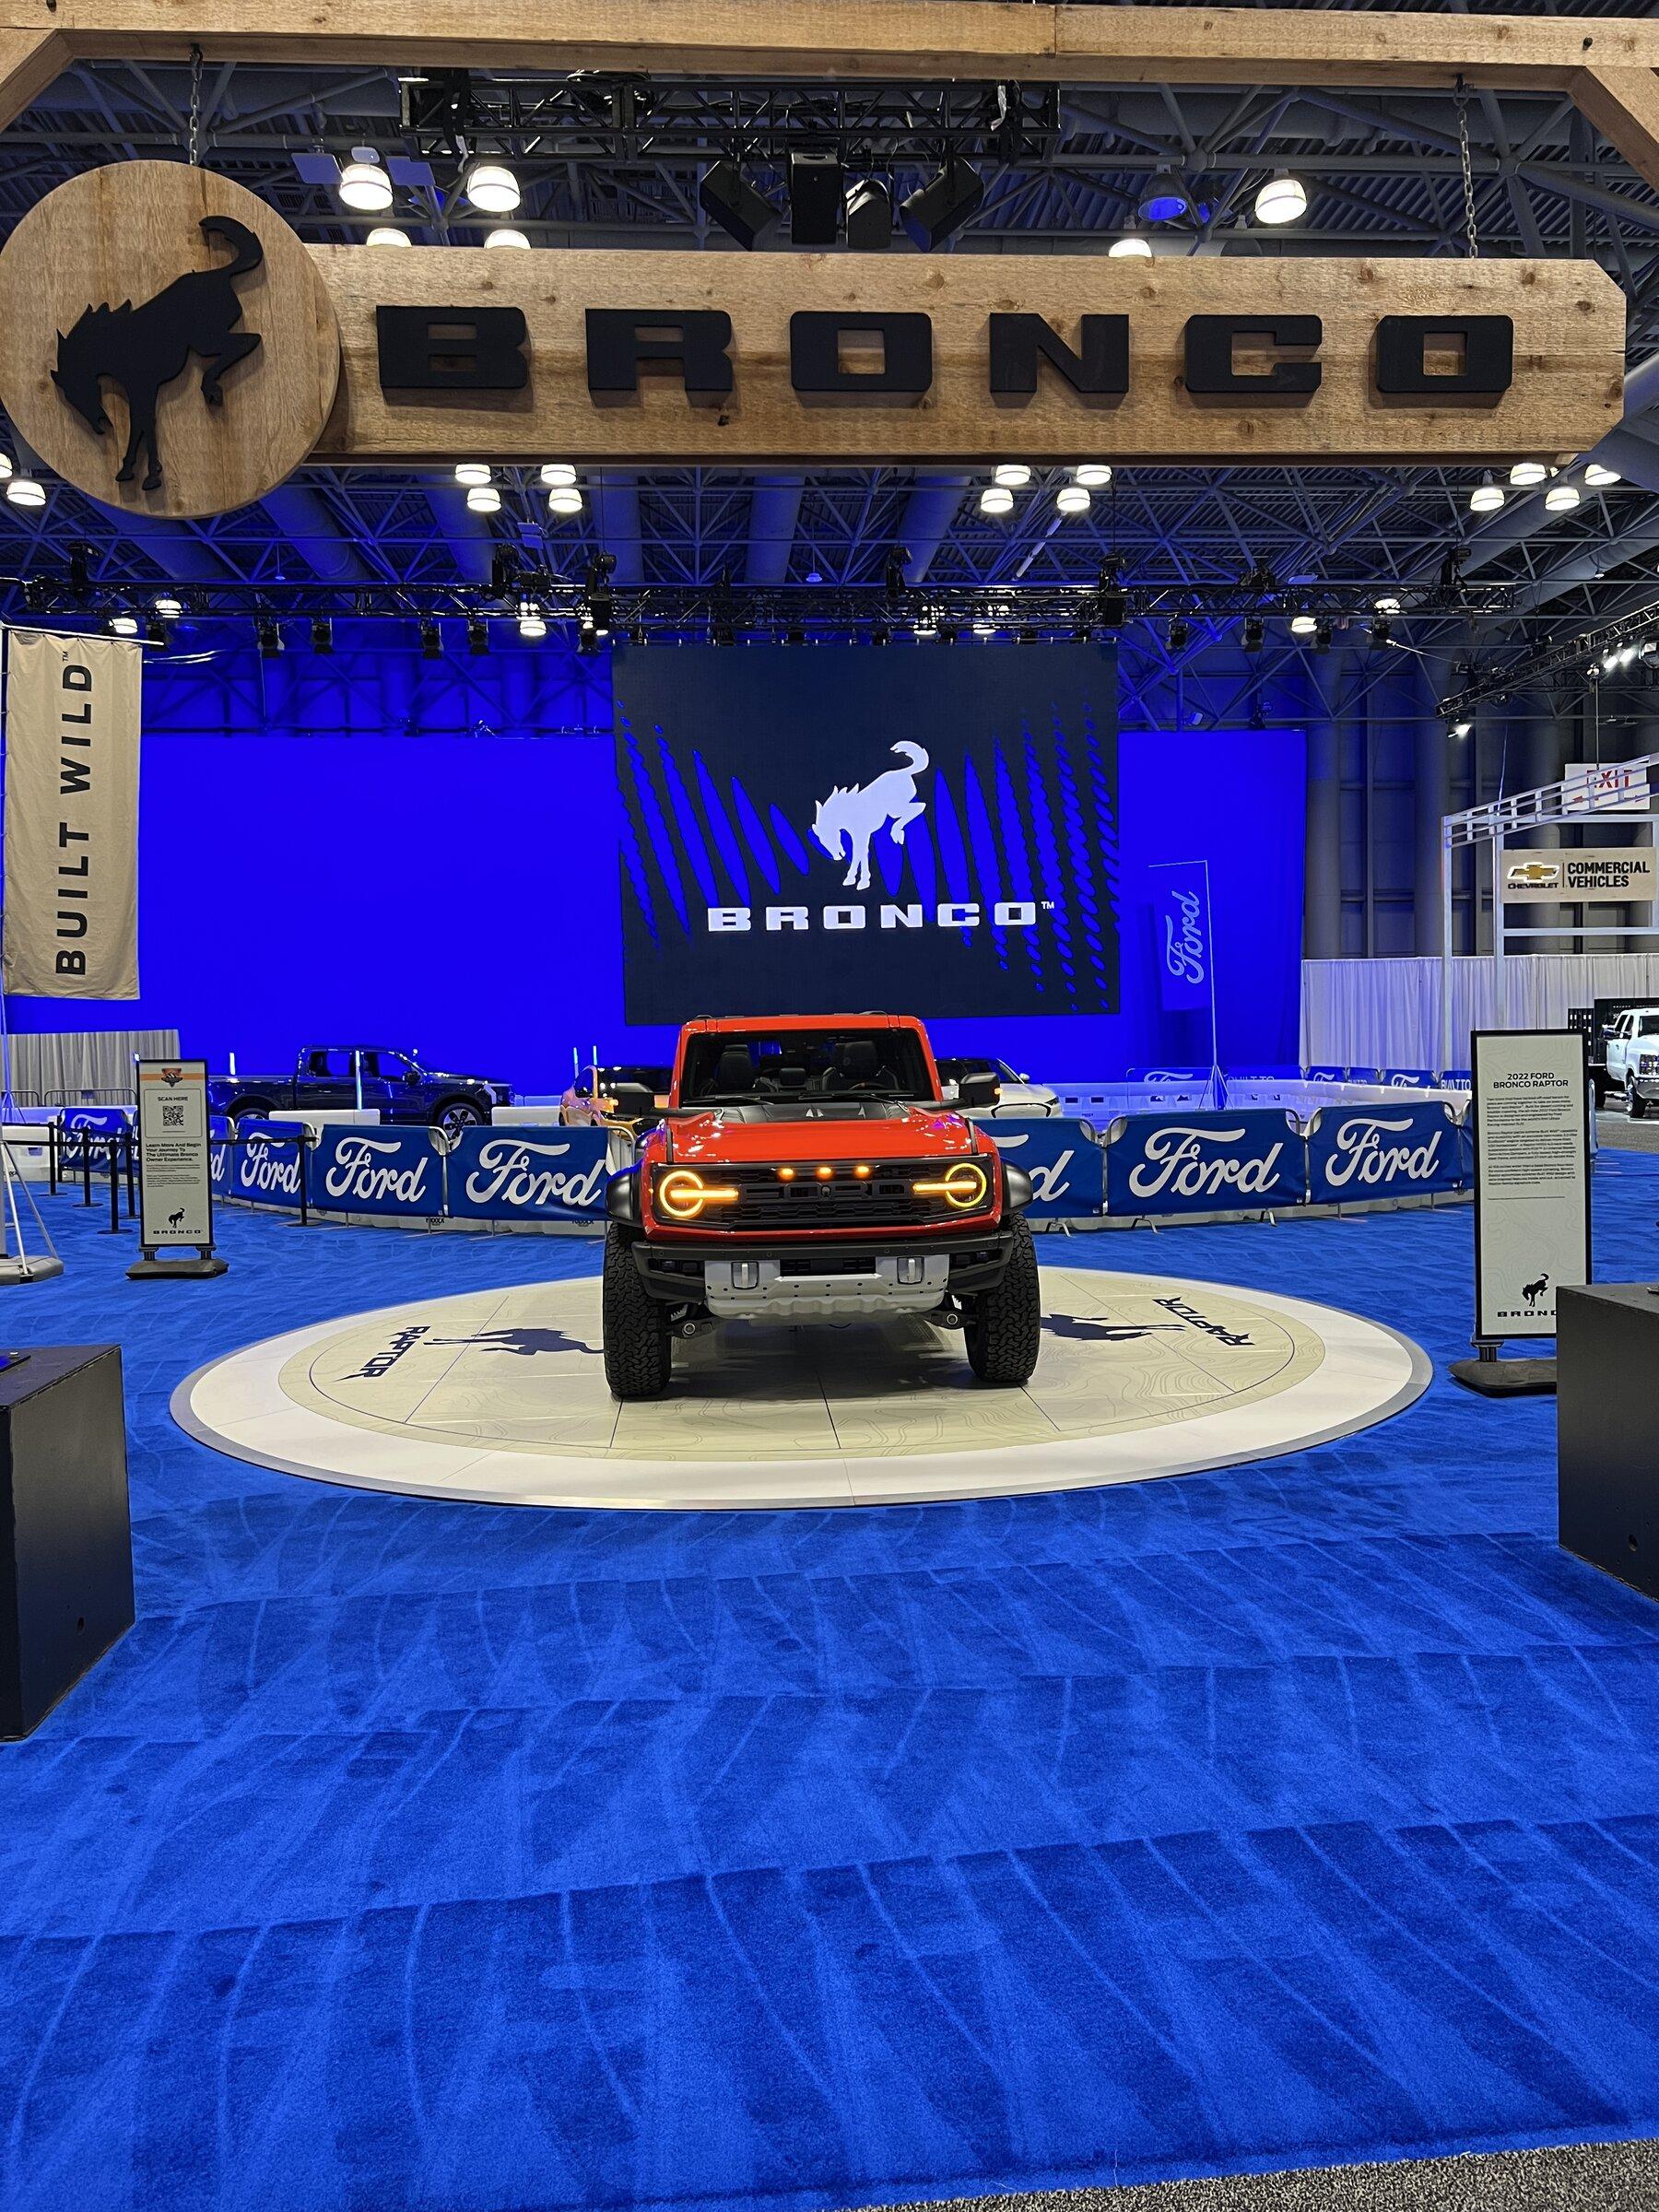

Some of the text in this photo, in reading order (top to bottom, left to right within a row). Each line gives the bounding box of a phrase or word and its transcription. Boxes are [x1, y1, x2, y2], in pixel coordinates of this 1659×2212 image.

[376, 305, 1514, 393] BRONCO
[55, 821, 90, 976] BUILT
[1568, 861, 1651, 875] COMMERCIAL
[1568, 875, 1630, 888] VEHICLES
[1165, 890, 1205, 984] Ford
[1493, 1079, 1569, 1088] BRONCO RAPTOR
[241, 1132, 302, 1194] Ford
[325, 1136, 429, 1203] Ford
[465, 1138, 606, 1206] Ford
[1128, 1127, 1284, 1198] Ford
[1324, 1118, 1442, 1187] Ford
[738, 1179, 913, 1204] FORD
[1152, 1297, 1256, 1347] RAPTOR
[1497, 1310, 1557, 1318] BRONC
[333, 1325, 431, 1382] RAPTOR
